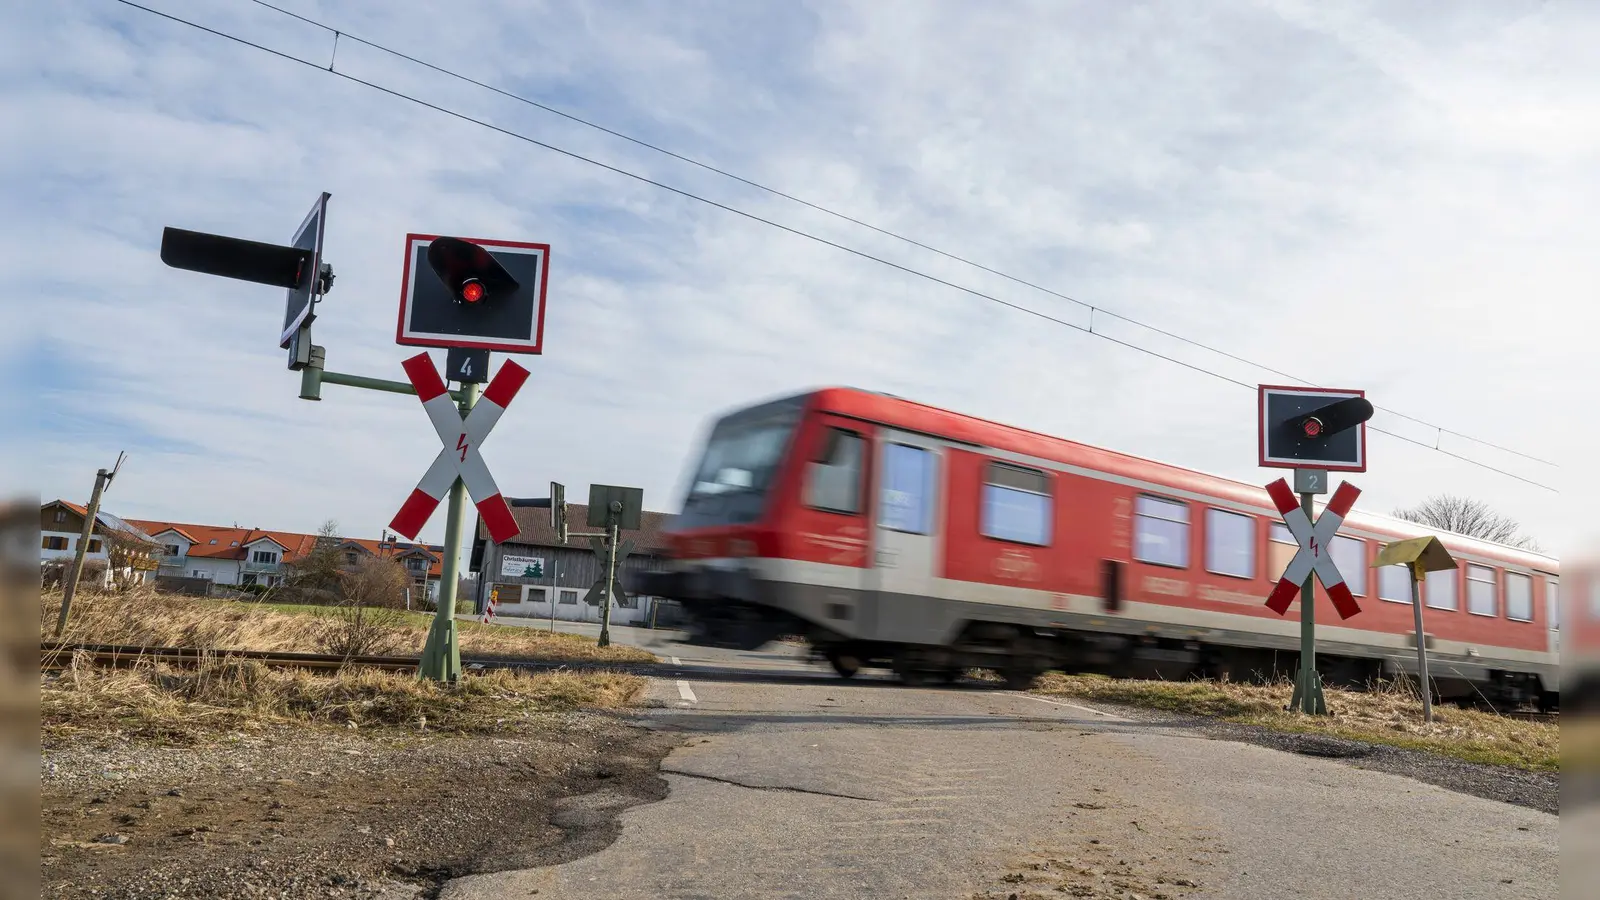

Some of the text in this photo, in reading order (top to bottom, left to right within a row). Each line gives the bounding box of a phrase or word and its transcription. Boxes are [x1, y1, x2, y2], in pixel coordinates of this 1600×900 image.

[460, 356, 472, 376] 4
[1308, 475, 1319, 489] 2
[503, 555, 537, 564] Christbäume
